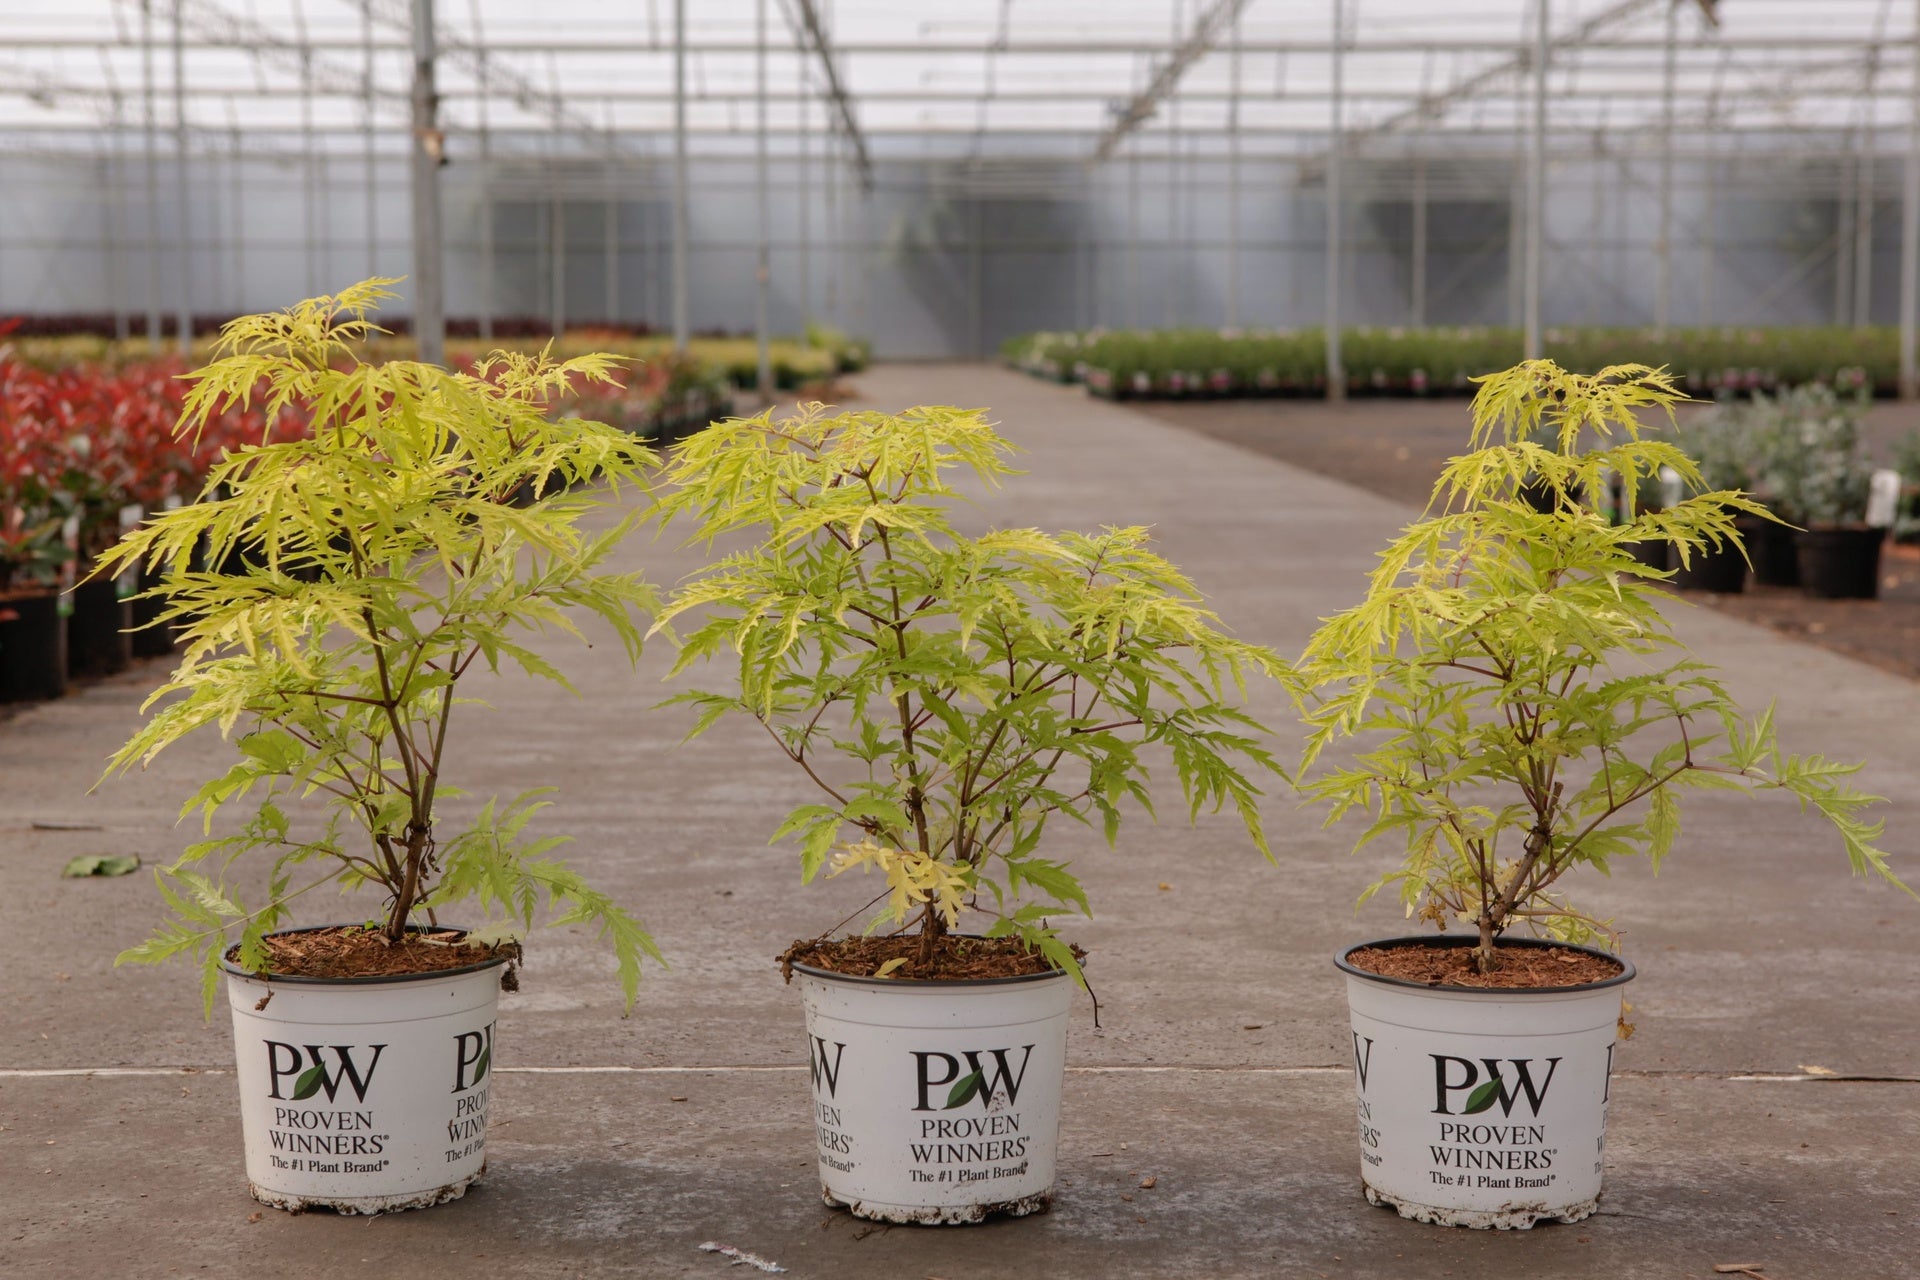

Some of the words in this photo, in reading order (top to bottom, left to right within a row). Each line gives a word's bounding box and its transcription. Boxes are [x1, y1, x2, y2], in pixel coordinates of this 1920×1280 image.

[275, 1107, 373, 1130] PROVEN
[921, 1113, 1020, 1138] PROVEN
[1440, 1122, 1545, 1145] PROVEN
[270, 1155, 289, 1170] The
[291, 1159, 303, 1171] #1
[308, 1160, 340, 1173] Plant
[445, 1150, 462, 1163] The
[909, 1169, 934, 1182] The
[938, 1170, 952, 1182] #1
[958, 1169, 989, 1182] Plant
[1429, 1171, 1453, 1185] The
[1457, 1175, 1471, 1187] #1
[1477, 1175, 1511, 1188] Plant
